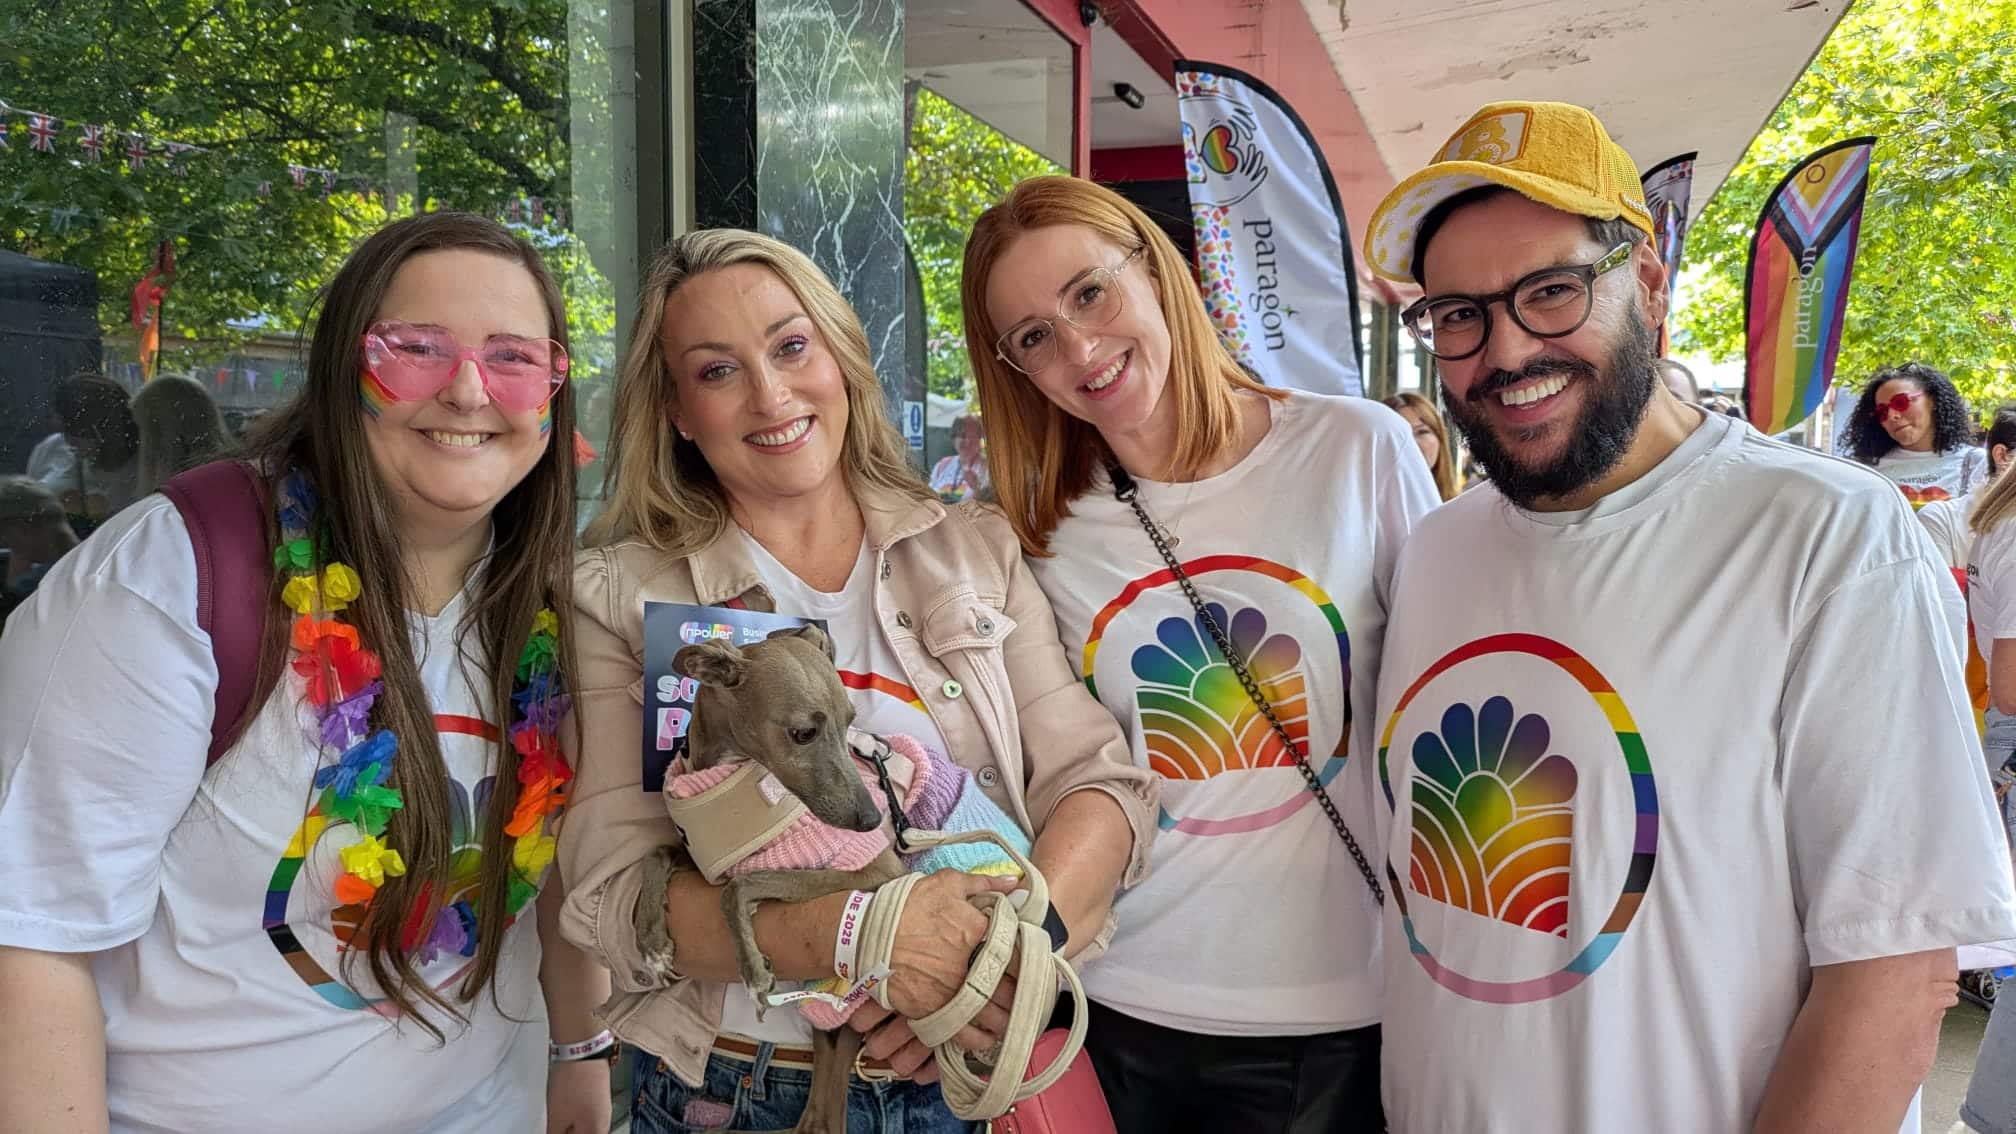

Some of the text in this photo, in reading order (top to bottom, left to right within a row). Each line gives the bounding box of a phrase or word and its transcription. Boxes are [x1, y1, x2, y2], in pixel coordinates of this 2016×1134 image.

[1242, 218, 1286, 352] paragon
[1791, 245, 1824, 349] paragon
[841, 913, 856, 946] 2025
